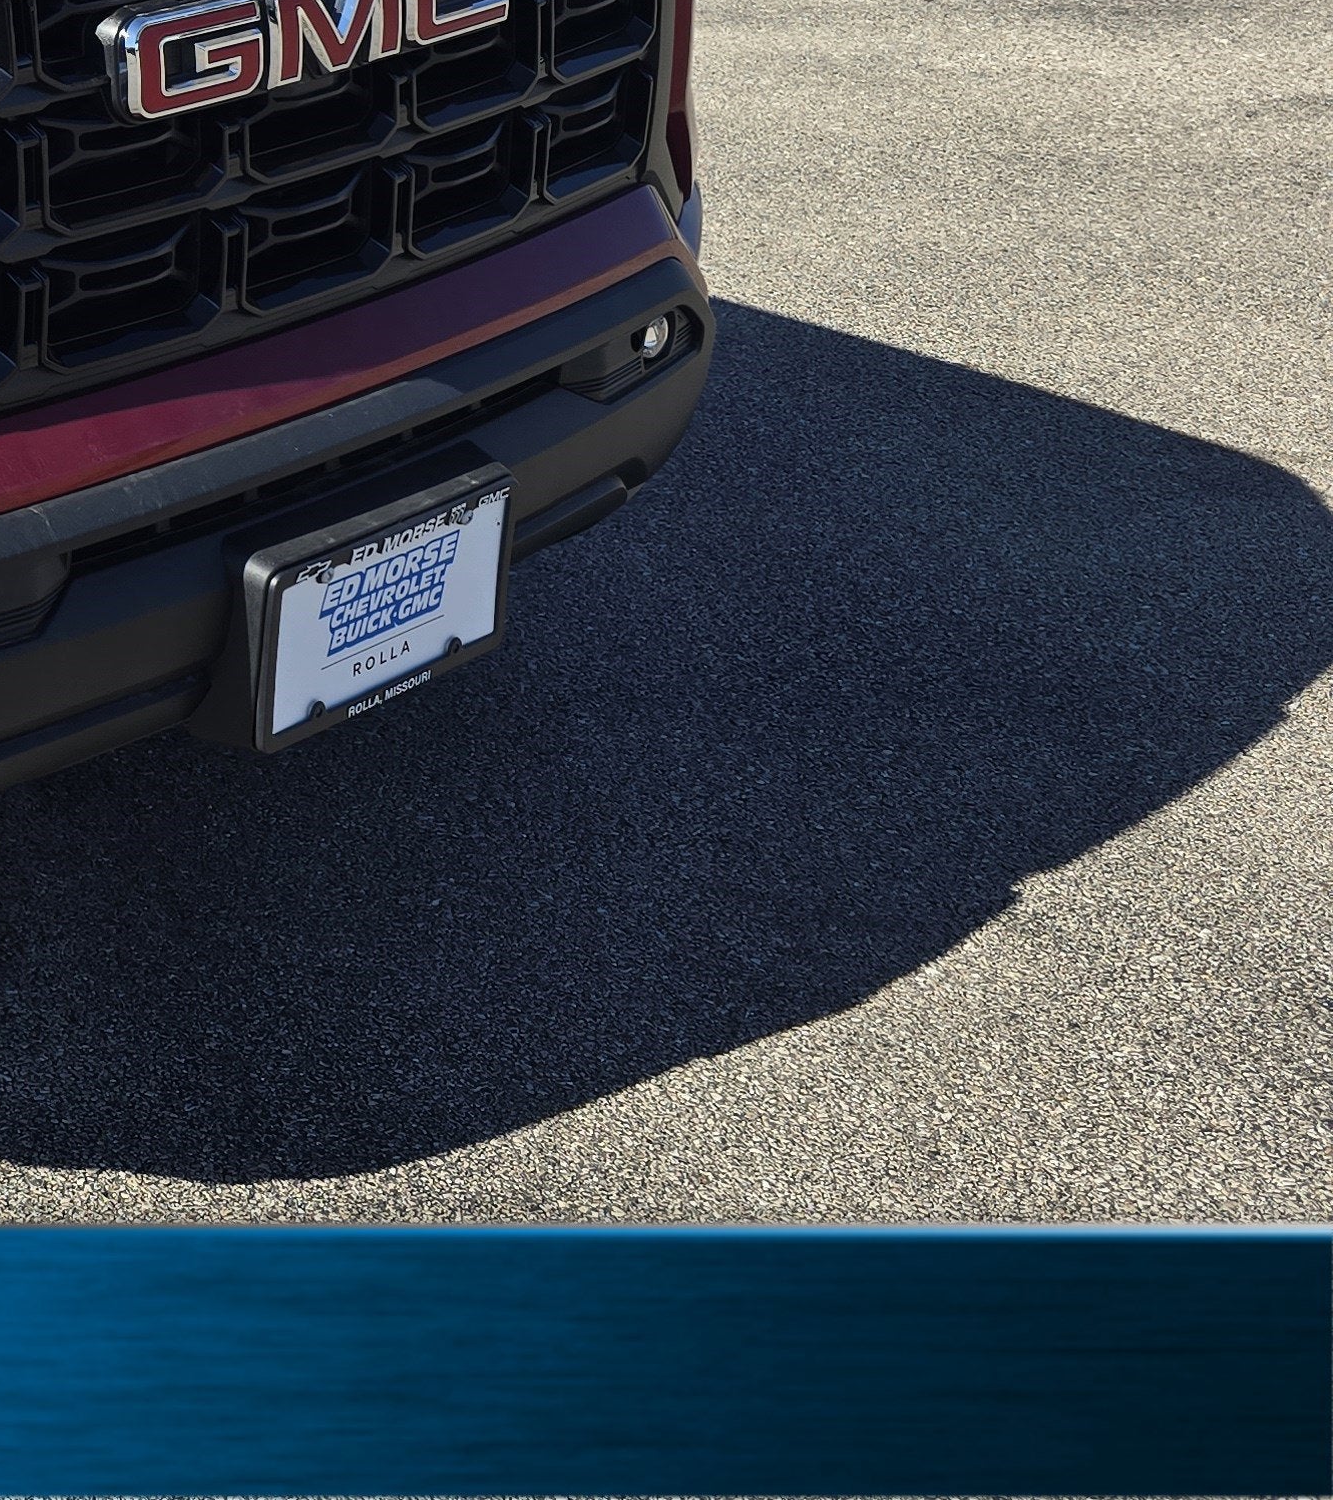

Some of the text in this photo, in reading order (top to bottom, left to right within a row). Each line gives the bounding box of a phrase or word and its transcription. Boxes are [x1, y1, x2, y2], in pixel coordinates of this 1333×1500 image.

[478, 486, 511, 508] GMC
[351, 512, 447, 564] ED MORSE
[321, 532, 459, 612] ED MORSE
[352, 640, 411, 677] ROLLA
[347, 669, 432, 718] ROLLA, MISSOURI
